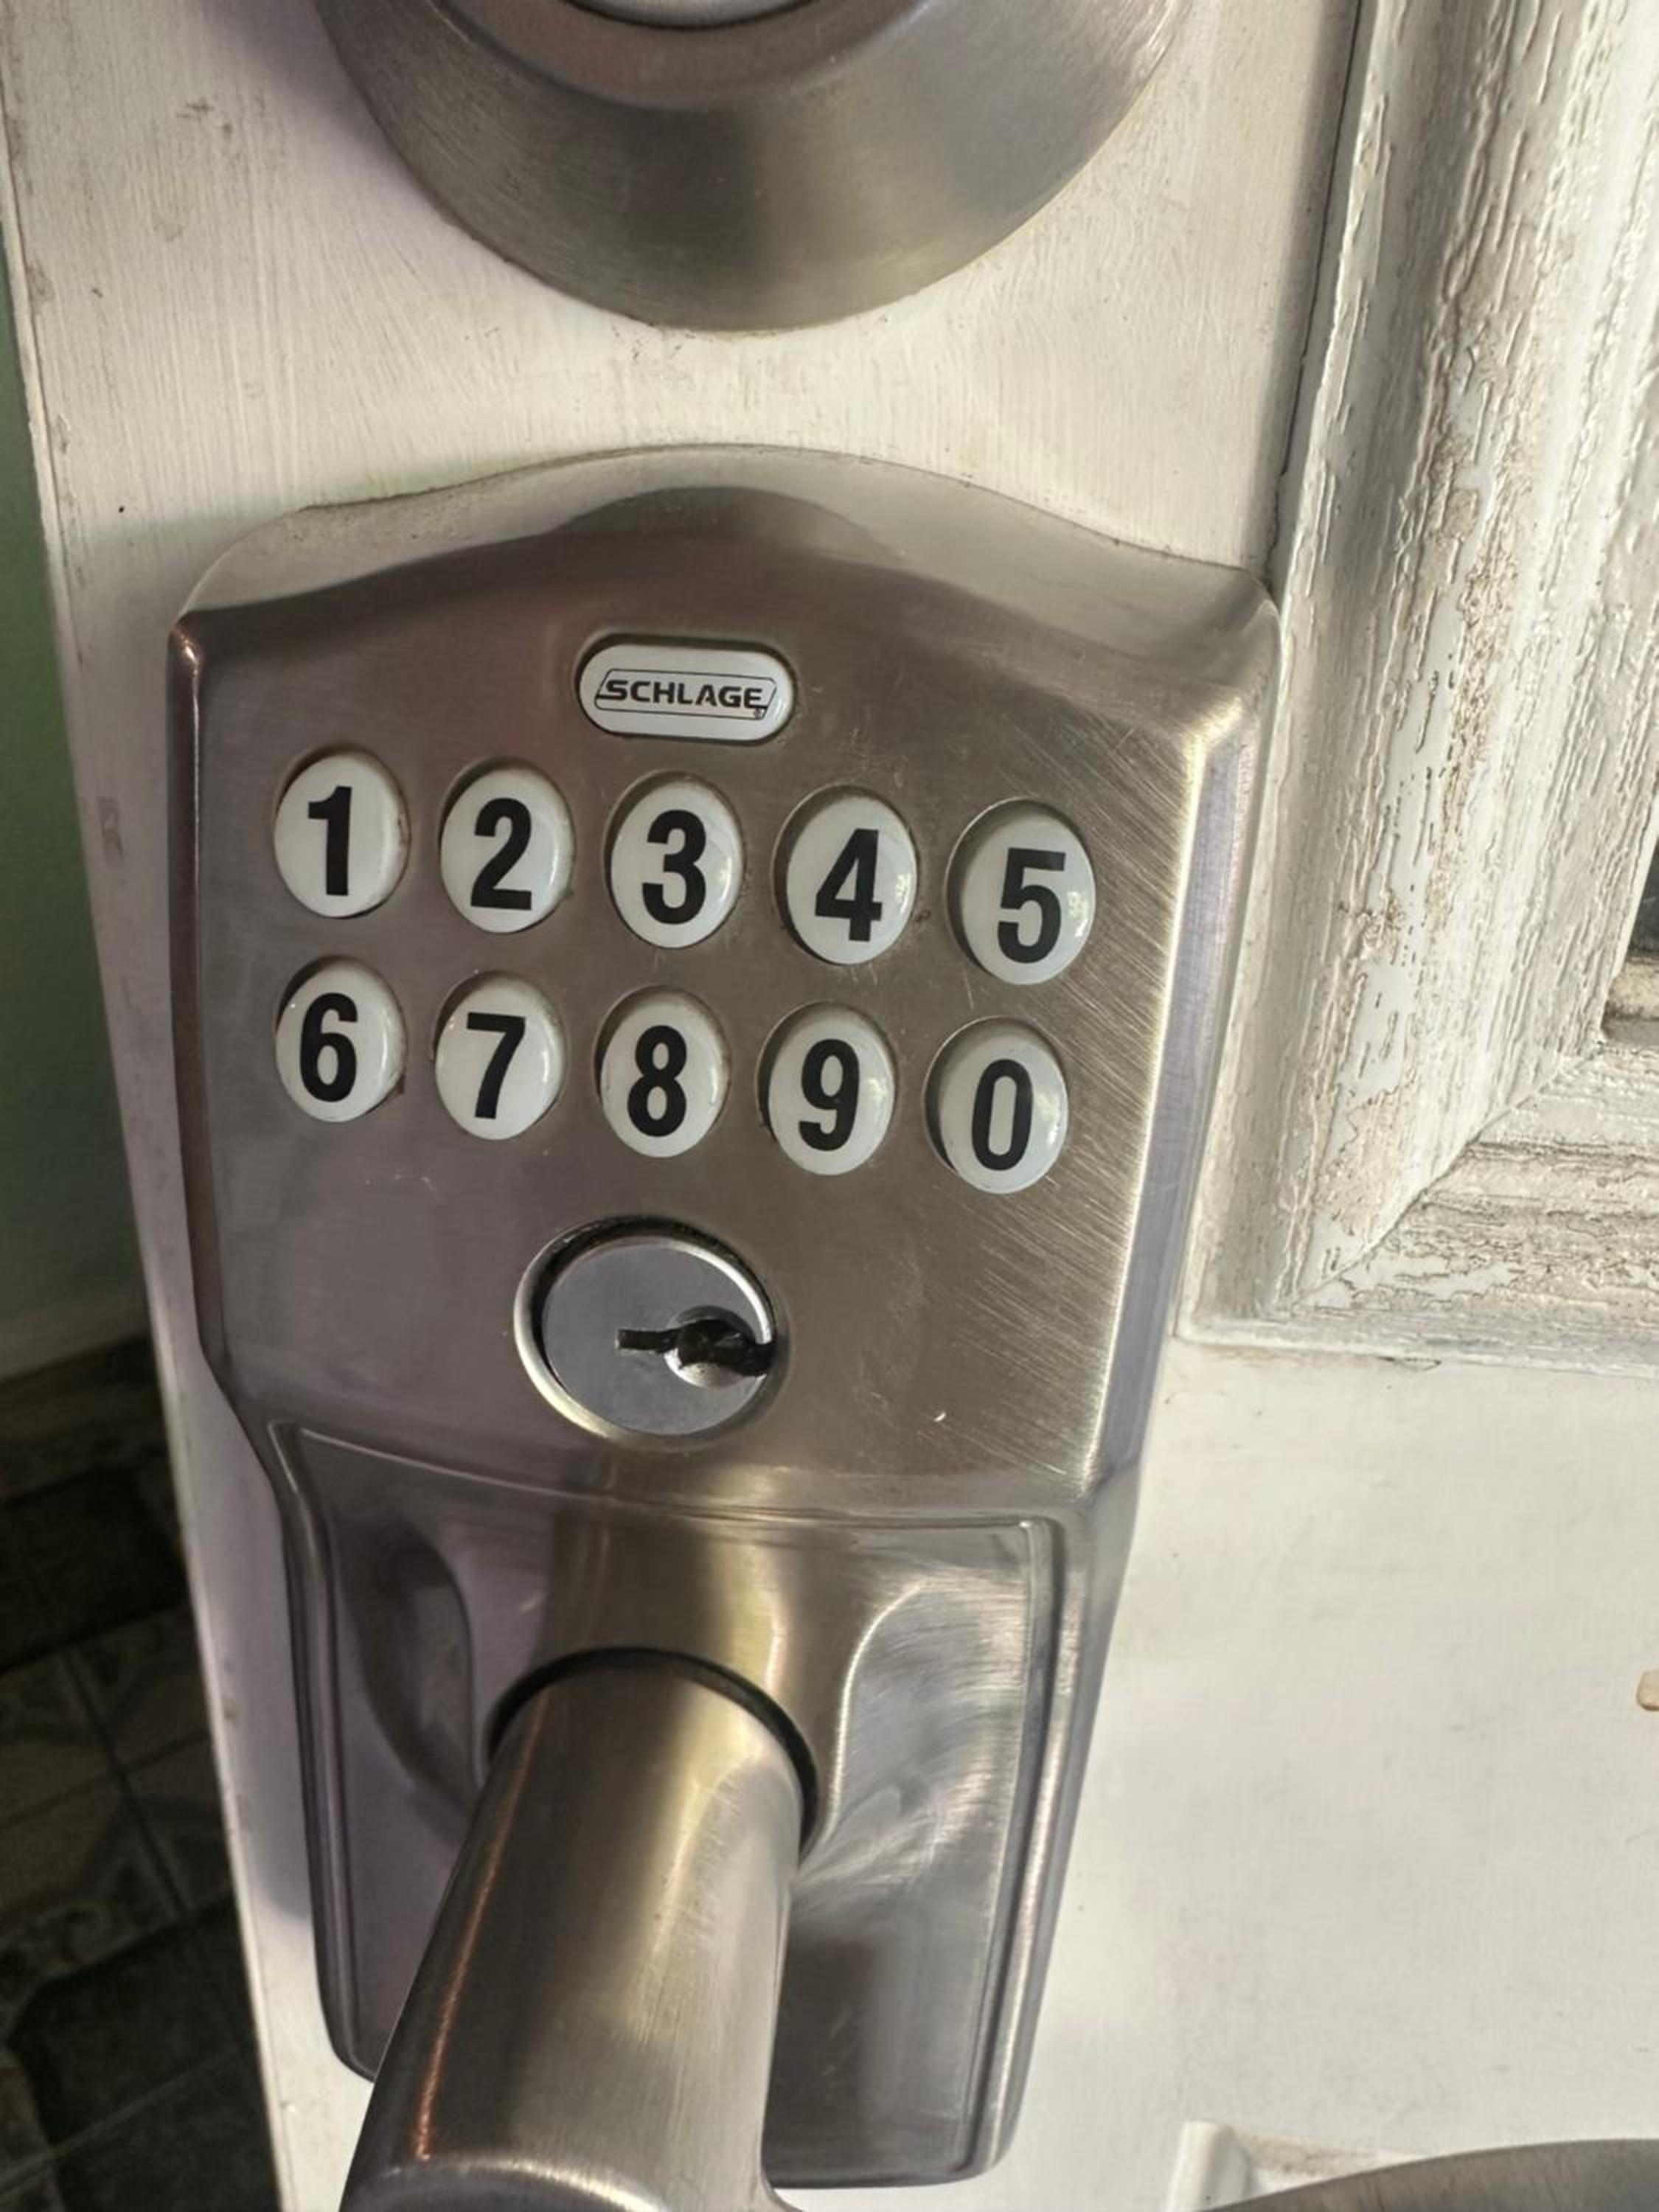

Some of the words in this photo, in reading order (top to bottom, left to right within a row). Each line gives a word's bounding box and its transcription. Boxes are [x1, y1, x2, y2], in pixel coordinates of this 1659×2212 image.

[605, 679, 763, 709] SCHLAGE
[306, 785, 354, 897] 1
[469, 796, 533, 911] 2
[641, 808, 707, 926] 3
[813, 827, 883, 943] 4
[996, 846, 1067, 964] 5
[298, 991, 359, 1104] 6
[465, 1010, 526, 1121] 7
[625, 1023, 689, 1138] 8
[797, 1037, 861, 1152] 9
[970, 1057, 1034, 1172] 0
